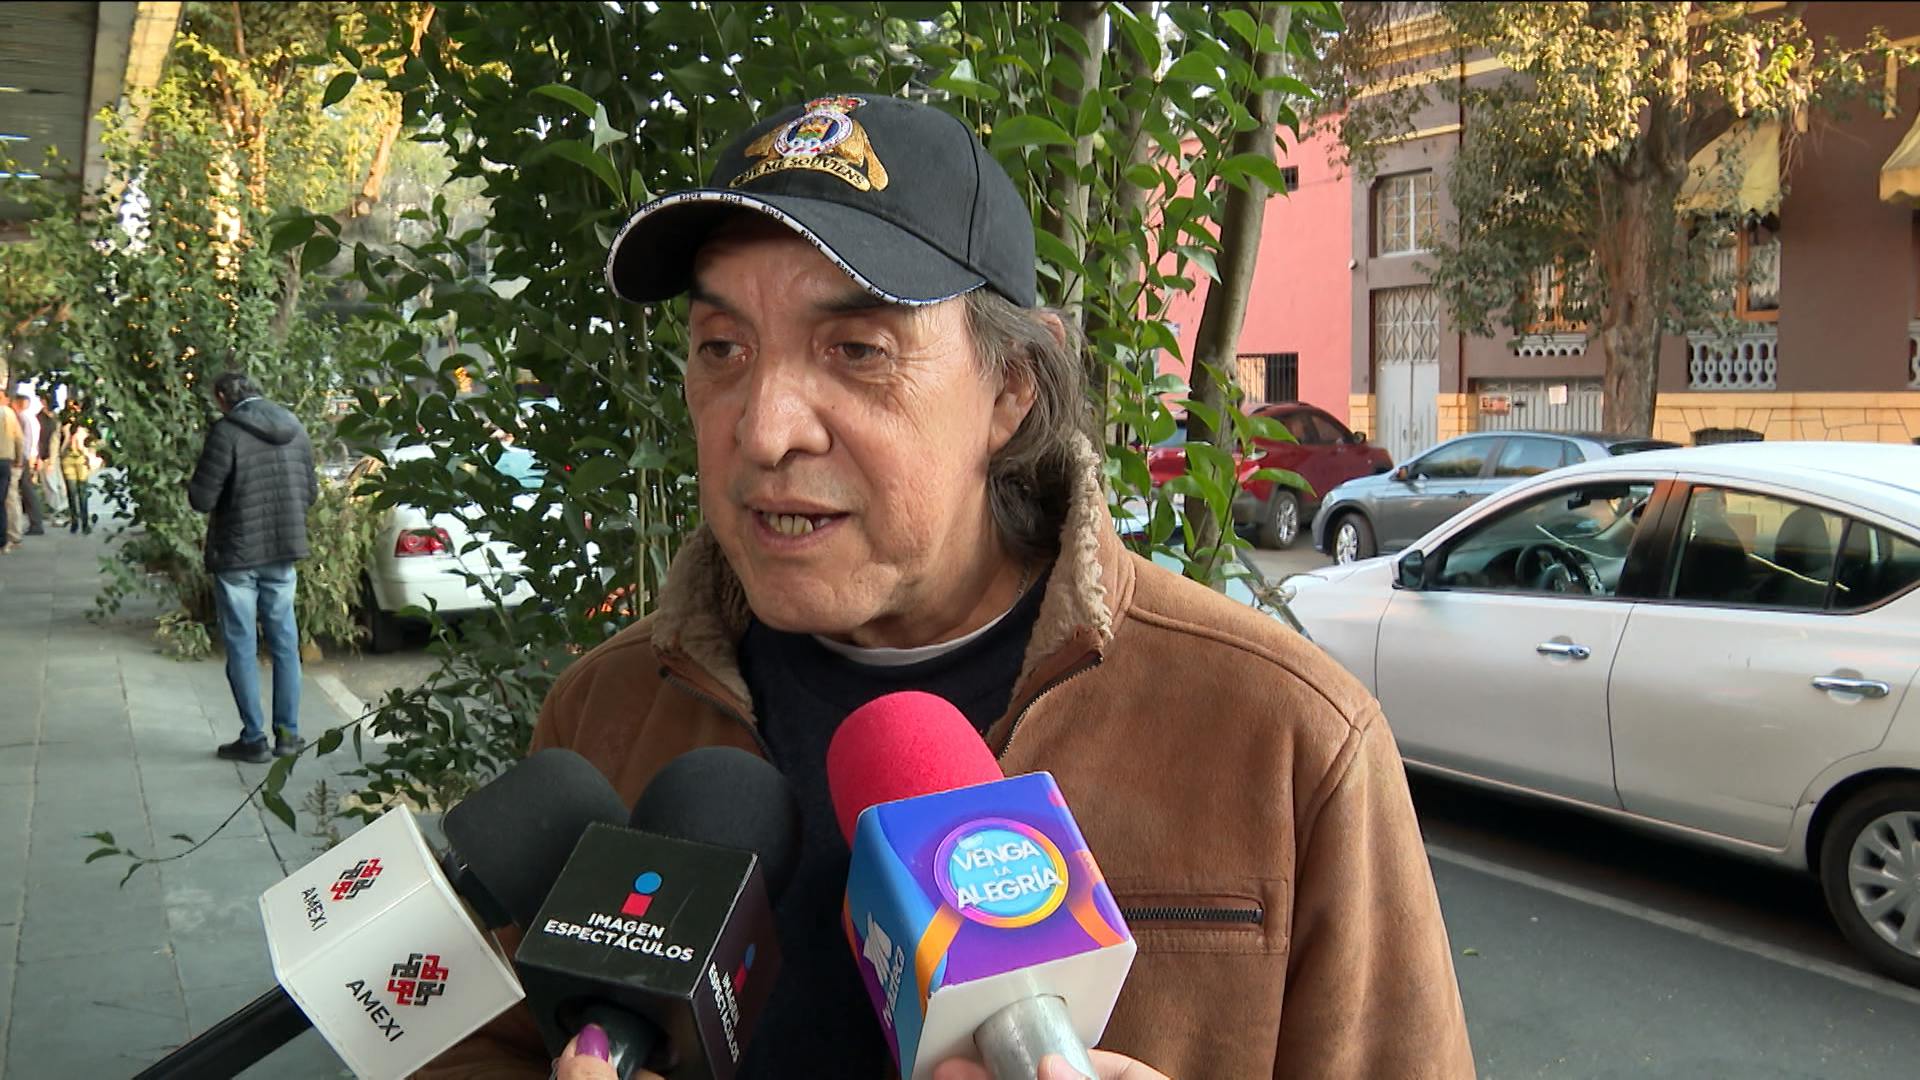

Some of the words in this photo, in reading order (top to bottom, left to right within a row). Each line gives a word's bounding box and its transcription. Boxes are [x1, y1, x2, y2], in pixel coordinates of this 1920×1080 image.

[952, 840, 1040, 871] VENGA
[993, 866, 1012, 878] LA
[958, 865, 1064, 909] ALEGRÍA
[301, 887, 327, 931] AMEXI
[587, 913, 666, 939] IMAGEN
[543, 919, 694, 962] ESPECTÁCULOS
[345, 979, 405, 1042] AMEXI
